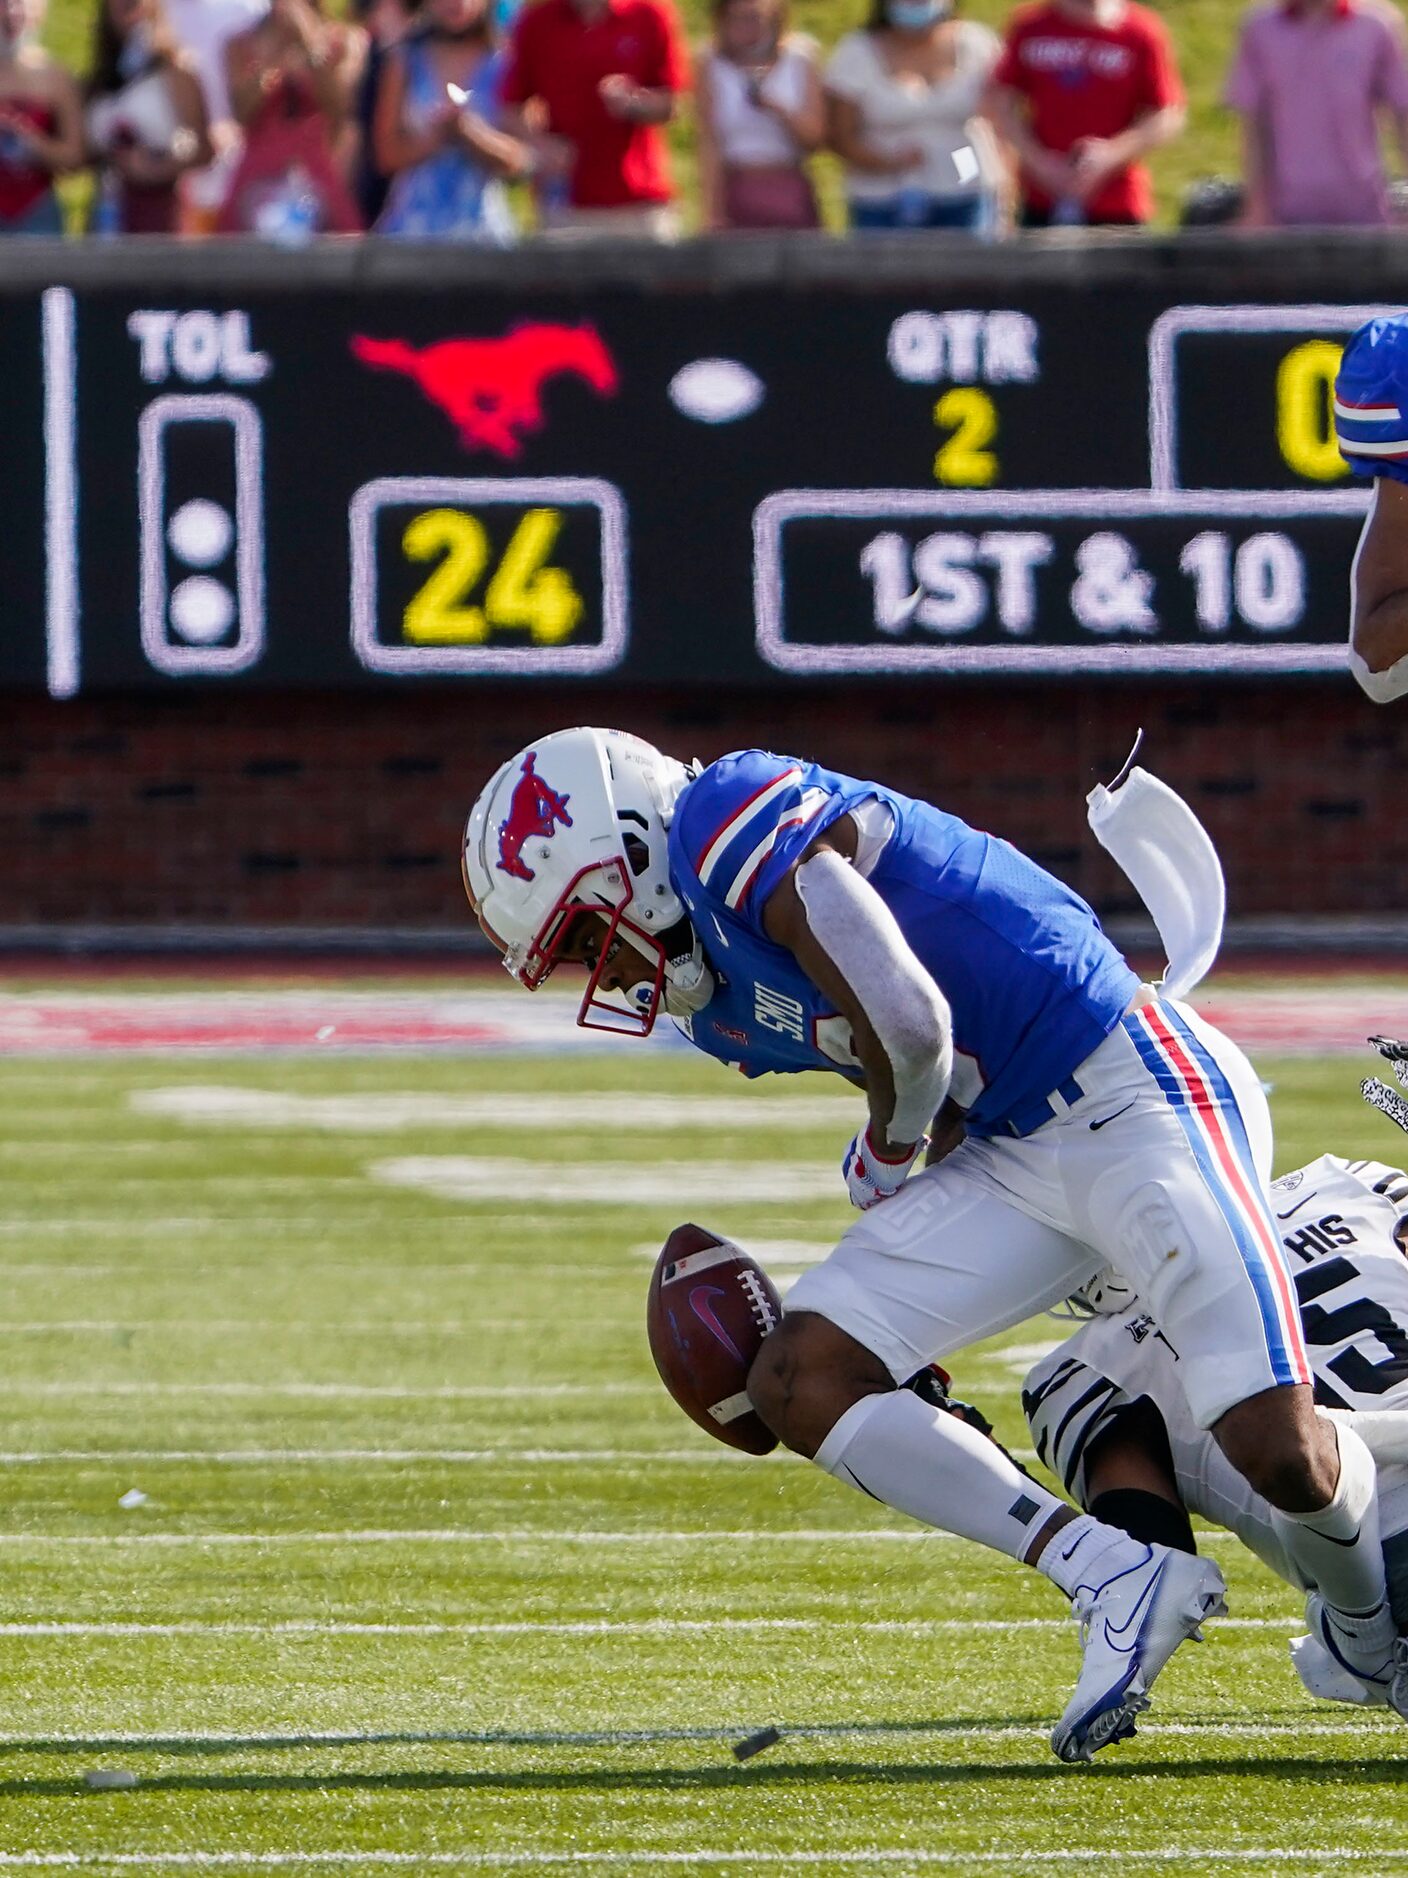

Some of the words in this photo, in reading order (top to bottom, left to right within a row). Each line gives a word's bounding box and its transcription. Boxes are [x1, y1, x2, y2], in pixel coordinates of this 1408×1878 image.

[127, 310, 272, 383] TOL
[887, 310, 1039, 384] QTR
[932, 387, 998, 487] 2
[402, 508, 583, 646] 24
[860, 531, 1055, 636] 1ST
[1070, 532, 1160, 636] &
[1178, 531, 1306, 634] 10
[754, 981, 804, 1042] SMU
